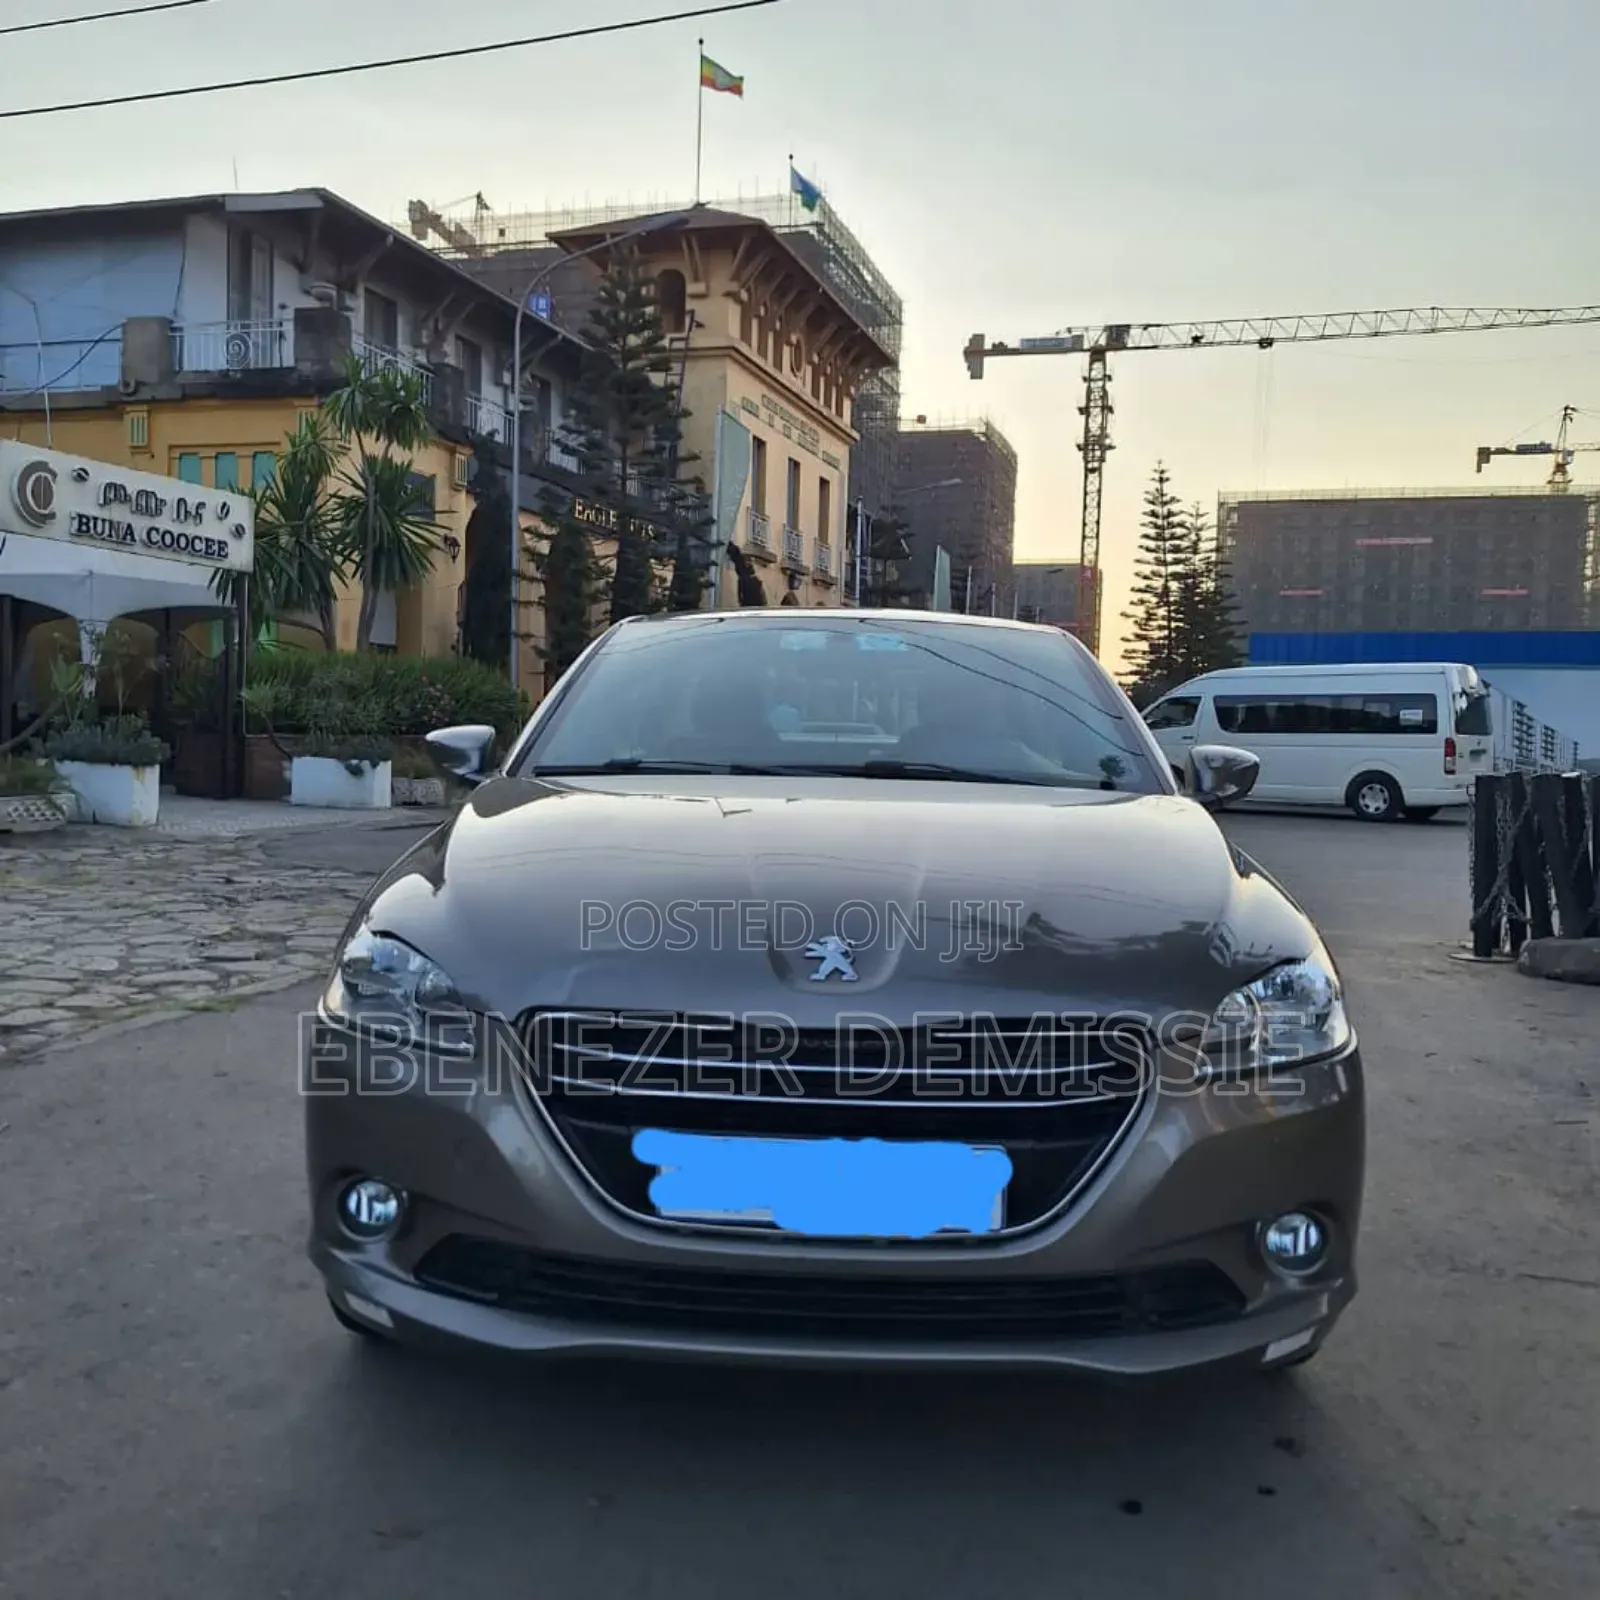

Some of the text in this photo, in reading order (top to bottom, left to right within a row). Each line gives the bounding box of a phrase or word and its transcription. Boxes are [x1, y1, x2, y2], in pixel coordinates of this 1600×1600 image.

[175, 497, 206, 525] ቡና
[73, 513, 229, 559] BUNA COOCEE
